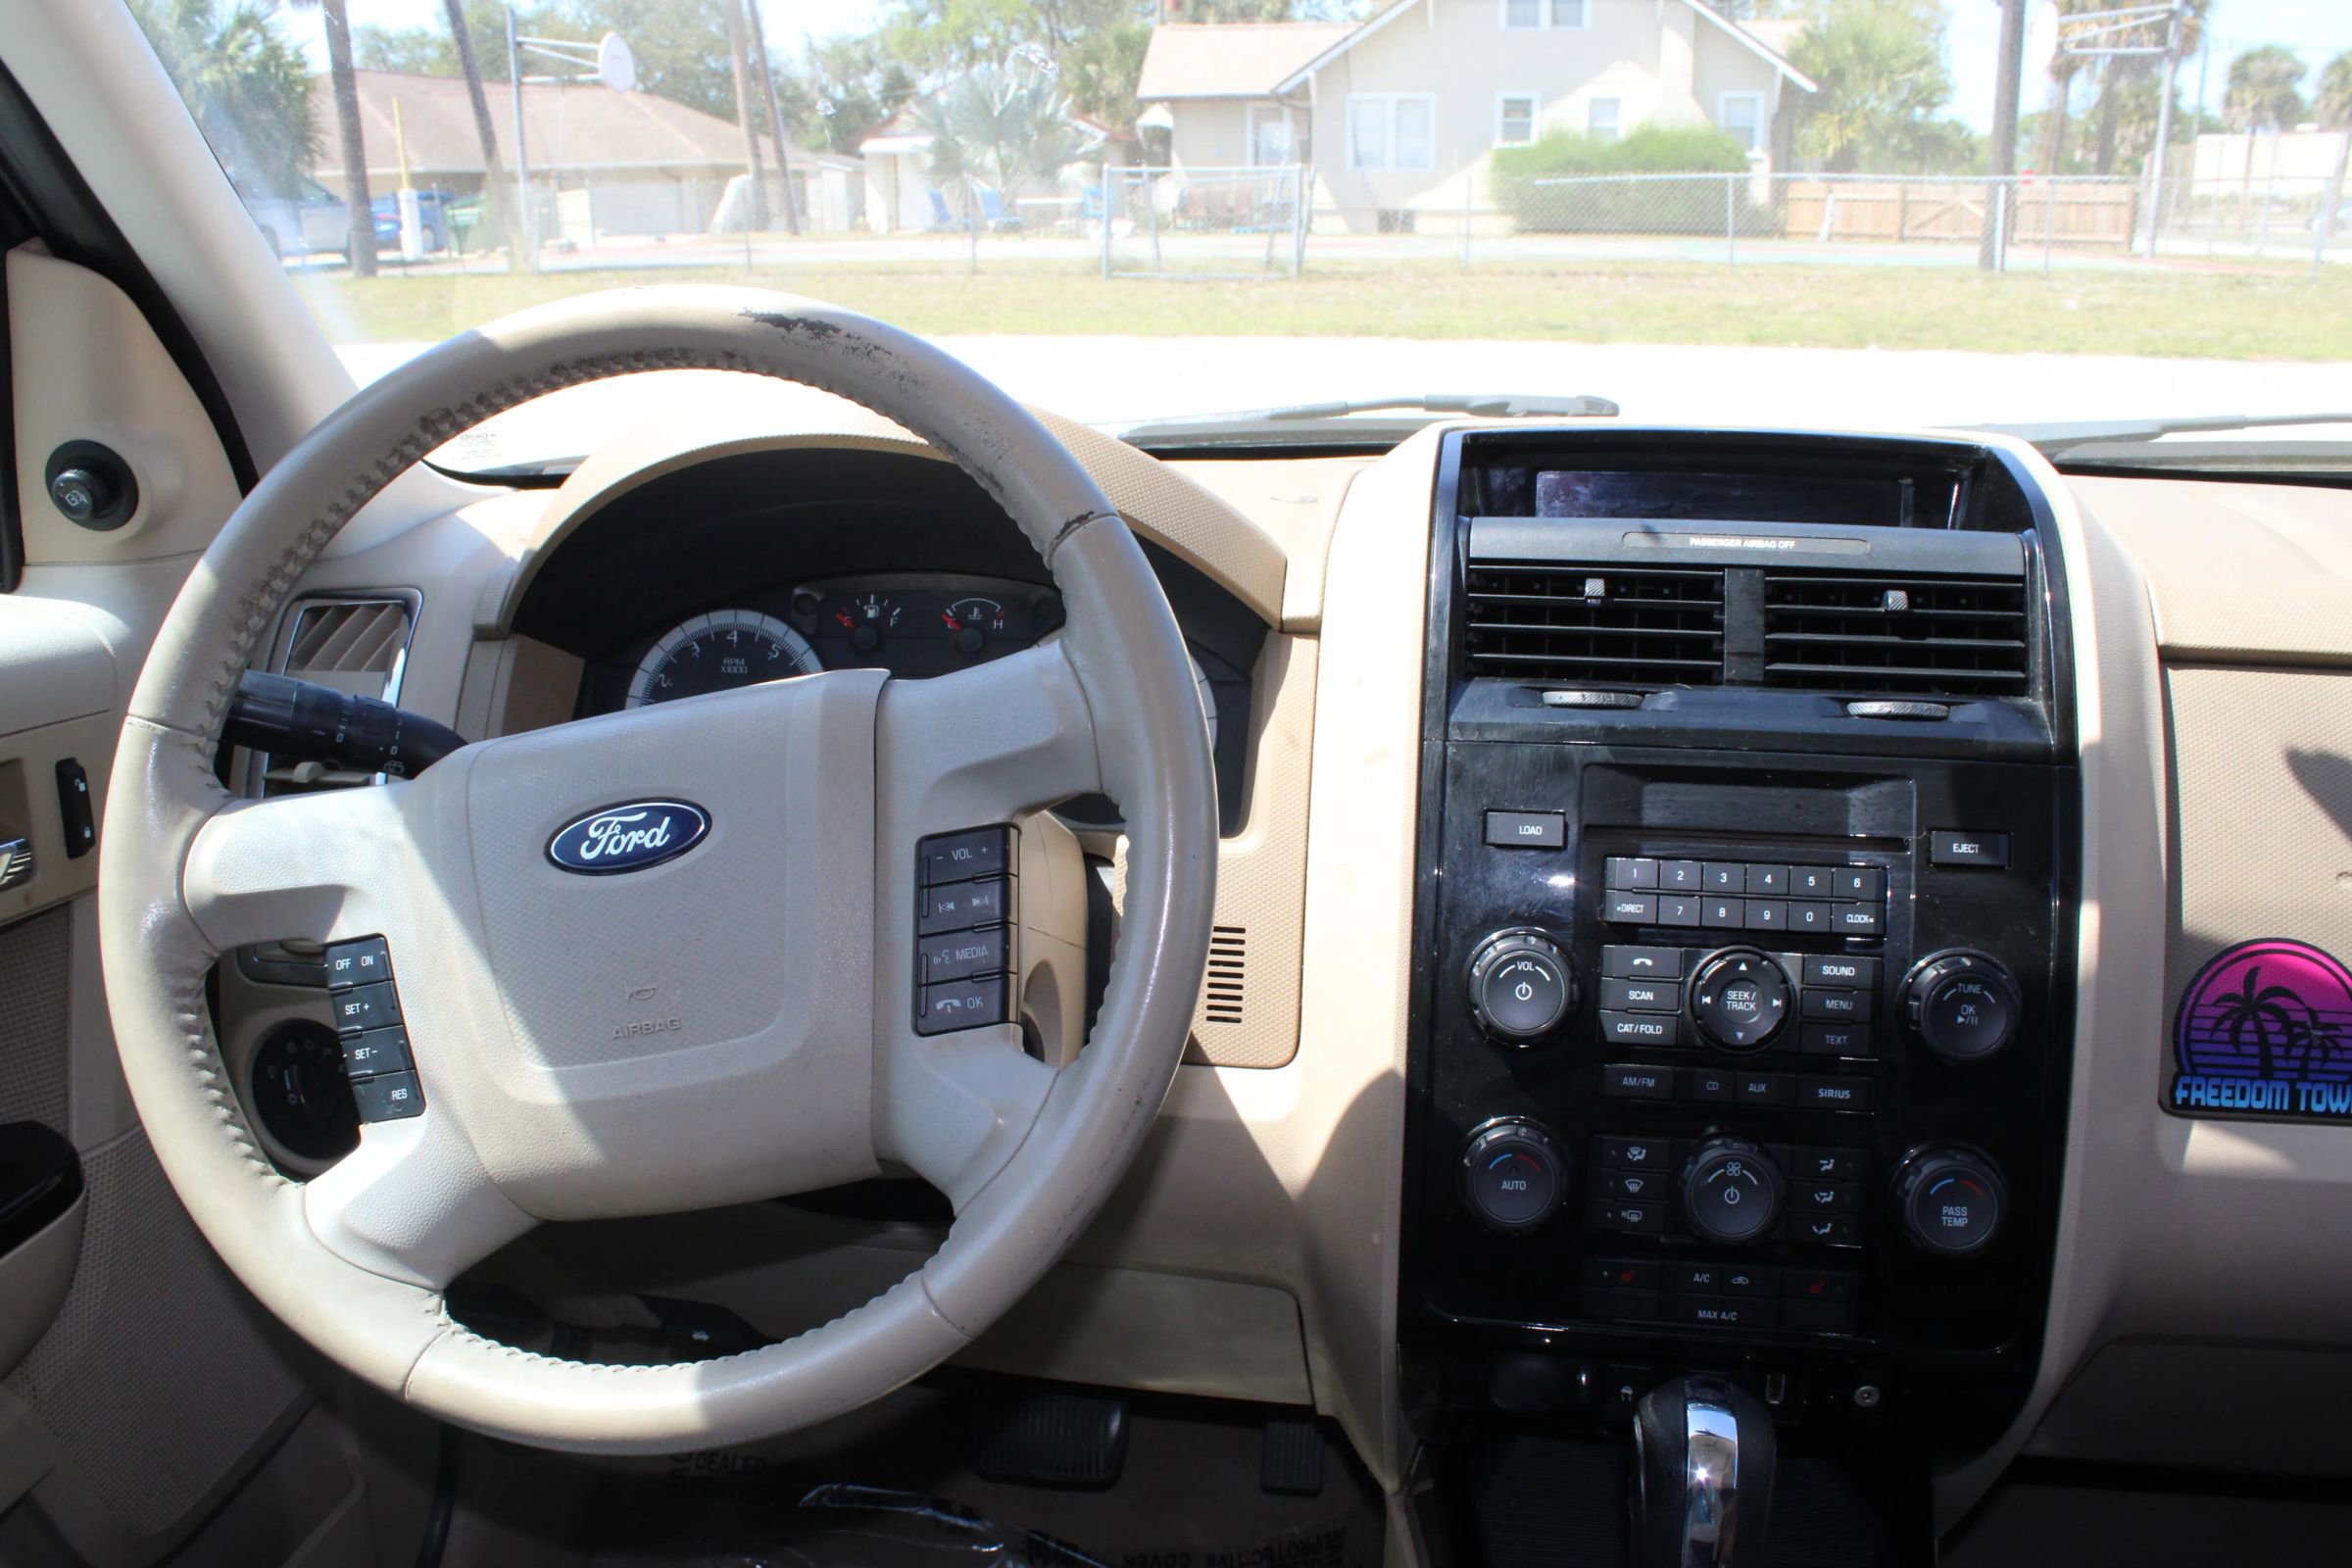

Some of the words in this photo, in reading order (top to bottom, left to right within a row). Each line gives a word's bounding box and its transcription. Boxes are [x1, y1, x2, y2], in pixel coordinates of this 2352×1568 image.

[1690, 537, 1742, 547] PASSENGER
[1743, 538, 1776, 549] AIRBAG
[1778, 540, 1795, 549] OFF
[890, 616, 899, 627] F
[993, 619, 1004, 629] H
[726, 630, 738, 643] 4
[771, 643, 782, 659] 5
[580, 811, 671, 860] Ford
[1519, 824, 1543, 836] LOAD
[952, 847, 973, 861] VOL
[1952, 843, 1981, 855] EJECT
[1633, 868, 1638, 878] 1
[1677, 870, 1684, 880] 2
[1720, 873, 1727, 883] 3
[1764, 874, 1772, 884] 4
[1808, 876, 1815, 886] 5
[1853, 877, 1861, 887] 6
[1621, 905, 1644, 913] DIRECT
[1677, 906, 1683, 915] 7
[1719, 907, 1726, 917] 8
[1764, 910, 1771, 920] 9
[1806, 911, 1813, 922] 0
[1846, 914, 1869, 924] CLOCK
[956, 945, 989, 960] MEDIA
[336, 958, 351, 970] OFF
[361, 955, 373, 967] ON
[1516, 961, 1535, 971] VOL
[1822, 965, 1855, 976] SOUND
[1957, 983, 1983, 994] TUNE
[1629, 990, 1653, 1001] SCAN
[967, 997, 984, 1009] OK
[1726, 1001, 1756, 1011] TRACK
[1826, 999, 1853, 1009] MENU
[345, 1003, 361, 1015] SET
[1960, 1004, 1976, 1015] OK
[612, 1018, 682, 1040] AIRBAG
[1825, 1035, 1847, 1045] TEXT
[355, 1048, 370, 1059] SET
[1622, 1076, 1655, 1087] AM/FM
[1706, 1081, 1719, 1090] CD
[1748, 1083, 1767, 1093] AUX
[392, 1088, 408, 1101] RES
[1818, 1088, 1851, 1100] SIRIUS
[2176, 1075, 2289, 1110] FREEDOM
[2295, 1081, 2352, 1114] TOW
[1501, 1180, 1527, 1191] AUTO
[1942, 1205, 1968, 1216] PASS
[1941, 1216, 1969, 1227] TEMP
[1693, 1273, 1710, 1283] A/C
[1697, 1309, 1717, 1319] MAX
[1720, 1311, 1738, 1321] A/C
